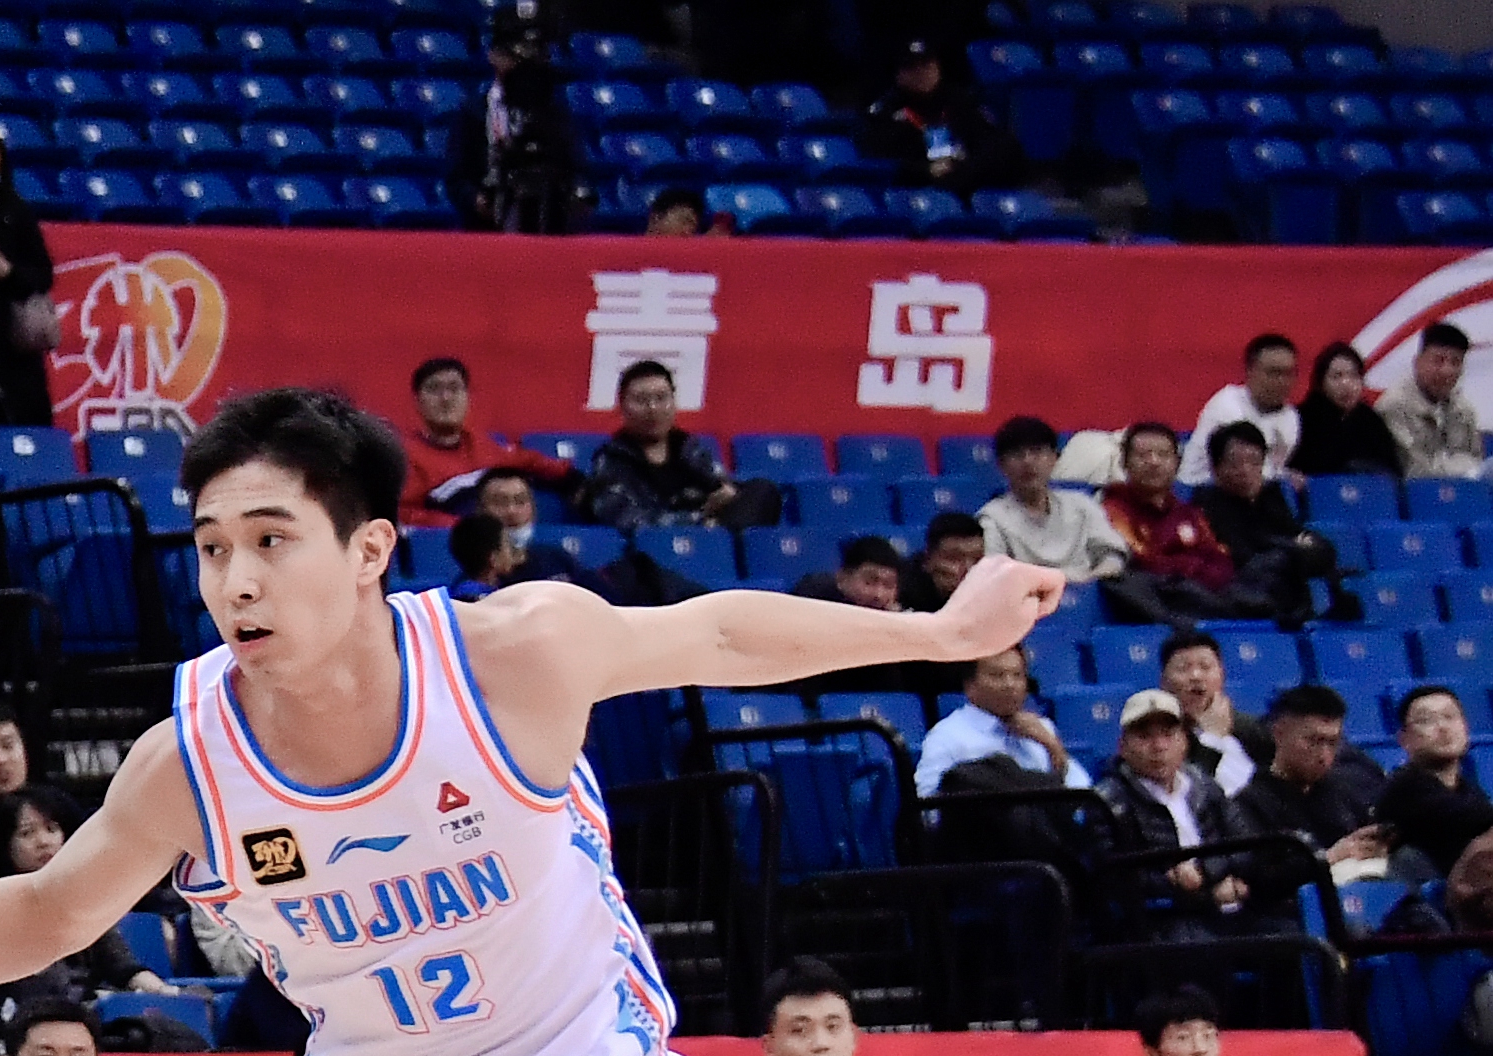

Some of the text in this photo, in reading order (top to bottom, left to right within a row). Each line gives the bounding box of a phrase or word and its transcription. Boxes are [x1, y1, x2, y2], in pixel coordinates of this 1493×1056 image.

[584, 267, 993, 413] 青岛
[453, 826, 482, 844] CGB
[272, 850, 518, 949] FUJIAN
[366, 949, 495, 1035] 12
